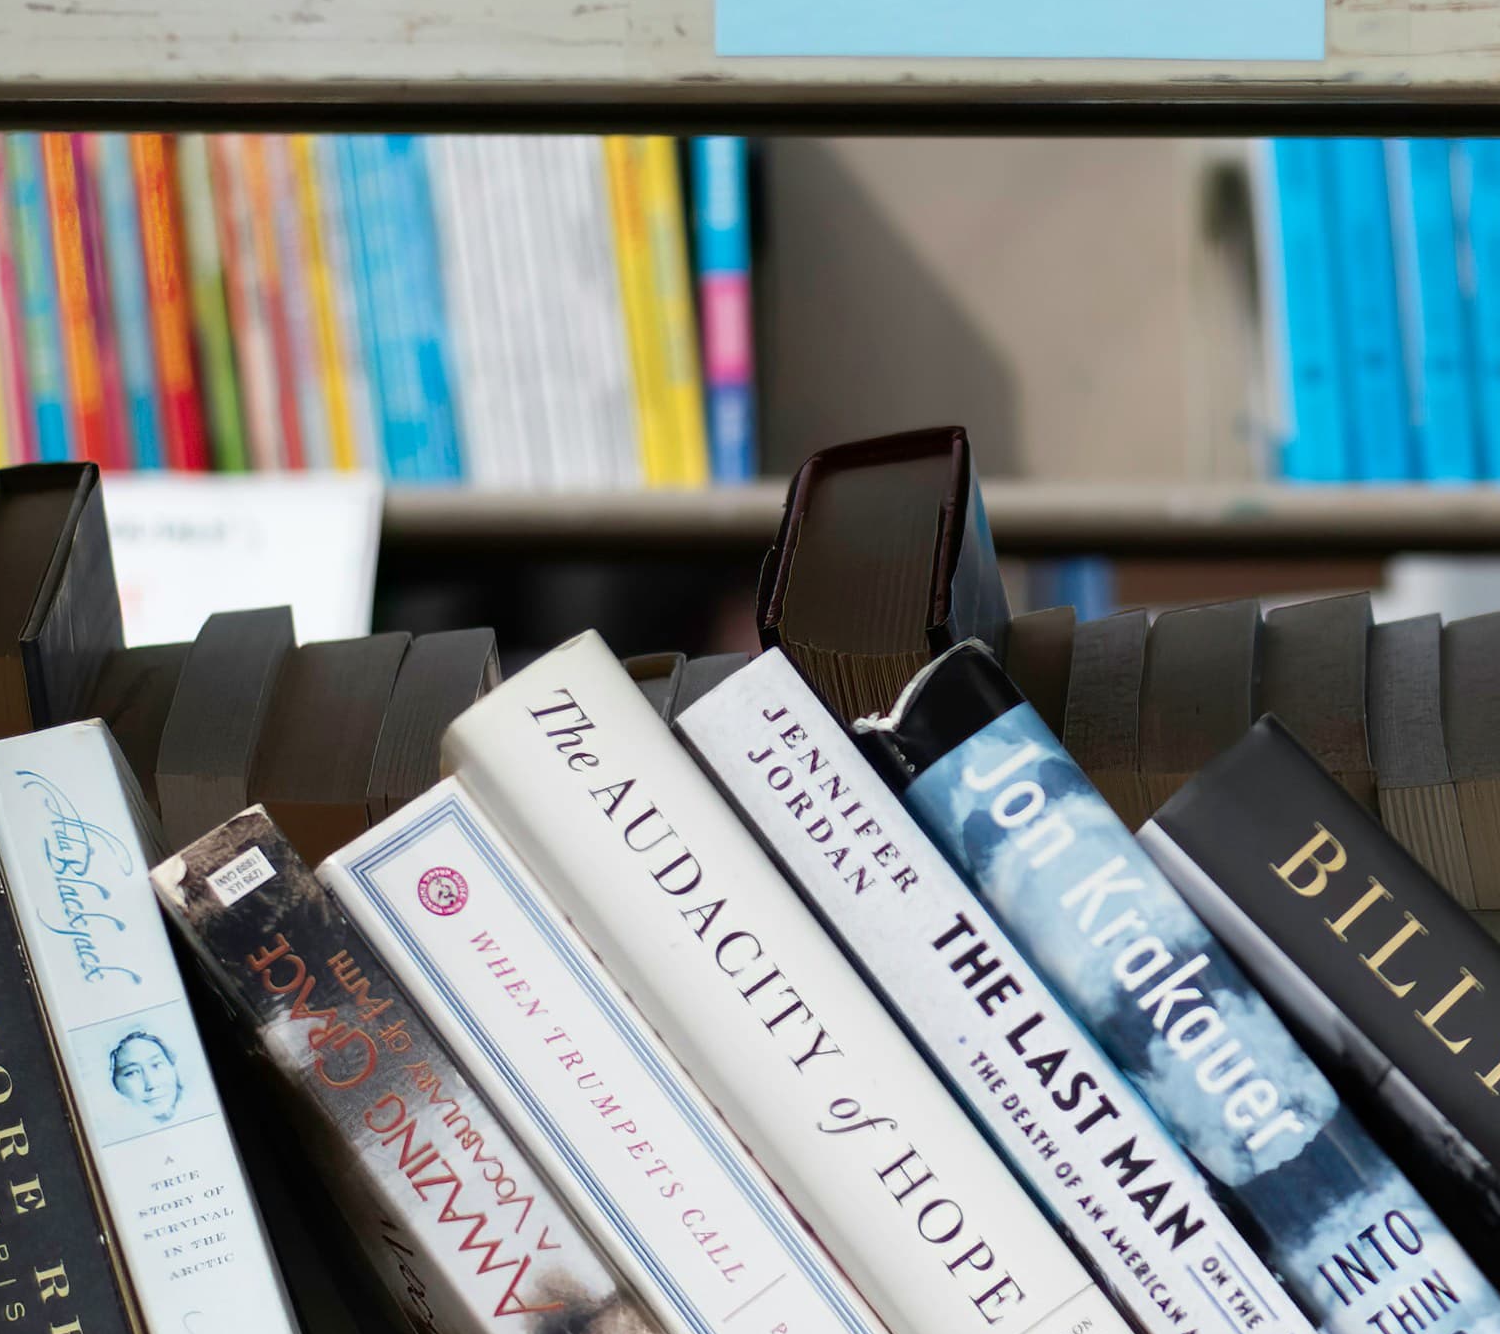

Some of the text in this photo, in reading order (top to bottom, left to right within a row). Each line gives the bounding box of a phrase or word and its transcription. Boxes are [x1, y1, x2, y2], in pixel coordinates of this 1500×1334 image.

[746, 746, 874, 896] JORDAN
[761, 706, 919, 894] JENNIFER
[962, 739, 1305, 1151] Jon Krakauer
[246, 932, 575, 1334] AMAZING GRACE
[528, 688, 1026, 1325] The AUDACITY of HOPE
[931, 912, 1023, 1018] THE
[1004, 1011, 1121, 1135] LAST
[1100, 1136, 1207, 1251] MAN
[1201, 1256, 1231, 1288] ON
[1226, 1287, 1265, 1330] THE
[1317, 1209, 1424, 1306] INTO
